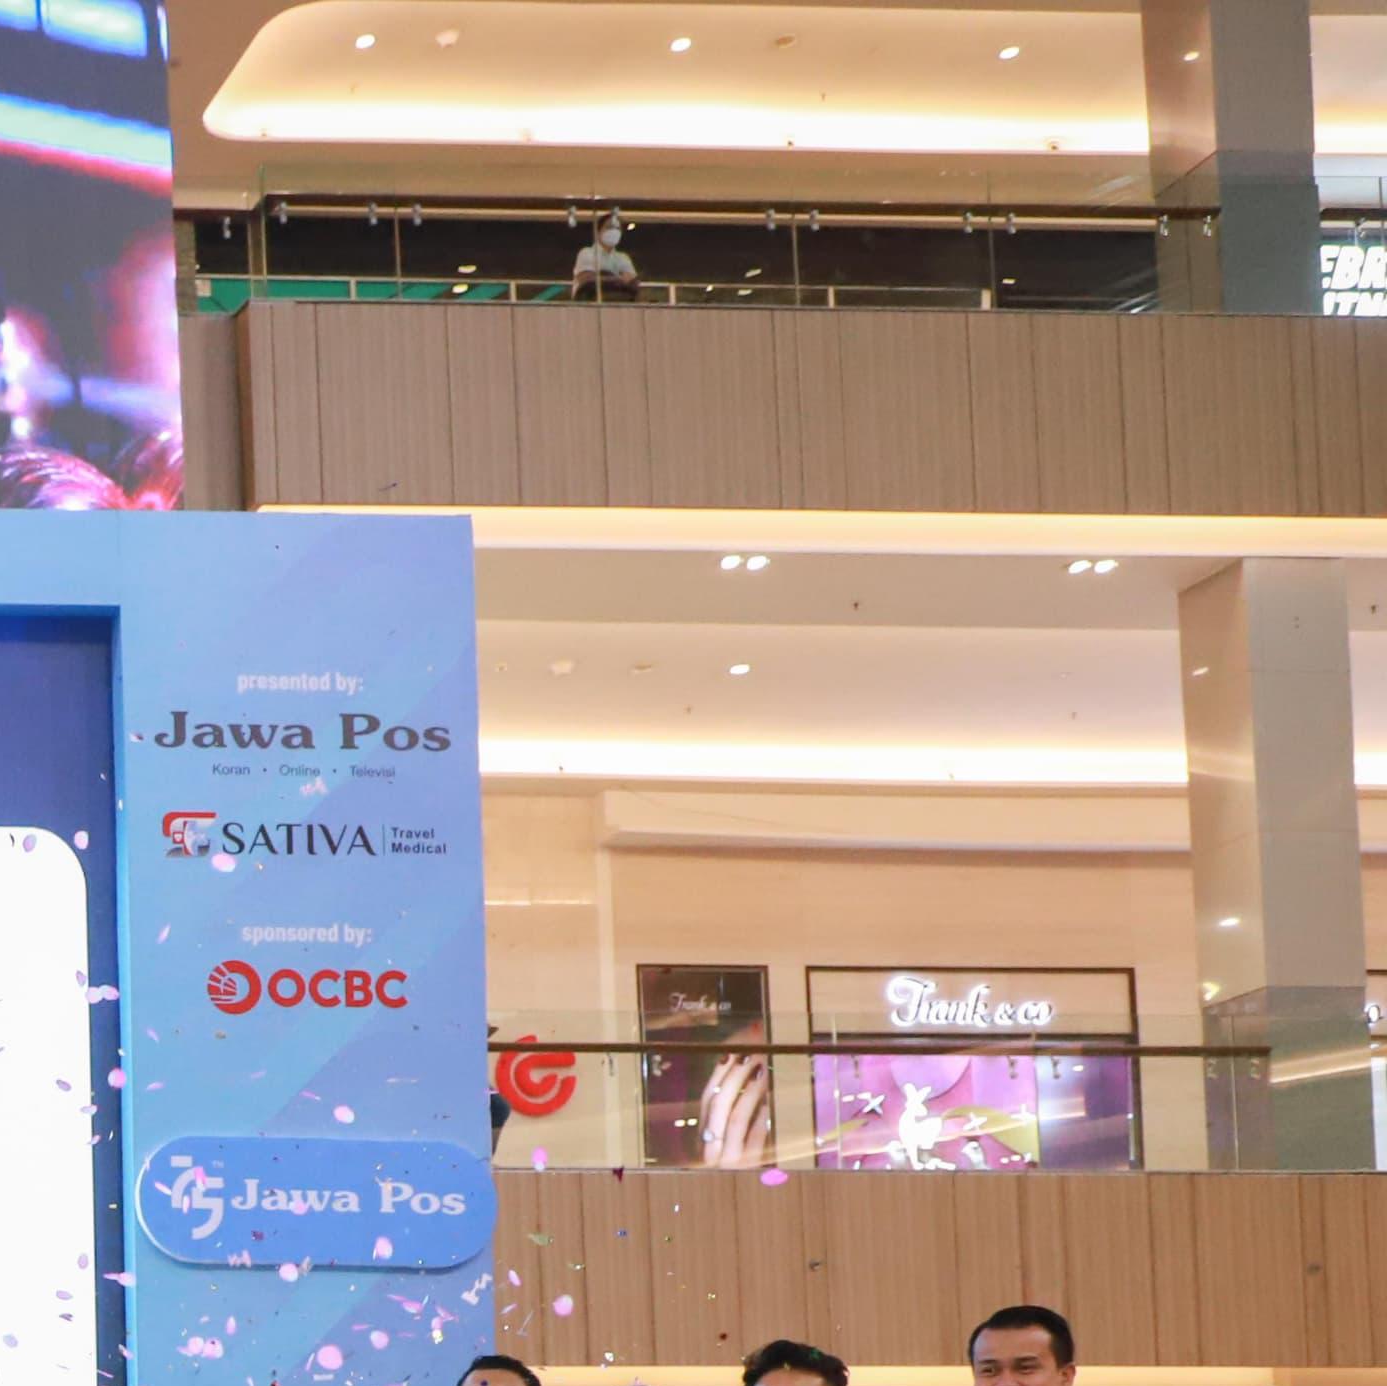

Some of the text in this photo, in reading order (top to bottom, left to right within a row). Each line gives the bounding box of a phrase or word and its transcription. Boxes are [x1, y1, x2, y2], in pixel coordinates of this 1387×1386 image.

[237, 672, 363, 696] presented by:
[154, 711, 452, 752] Jawa Pos
[212, 764, 396, 778] Koran Online Televisi
[222, 823, 376, 856] SATIVA
[392, 827, 435, 839] Travel
[391, 842, 447, 854] Medical
[241, 924, 372, 945] sponsored by:
[268, 969, 407, 1007] OCBC
[231, 1179, 466, 1216] Jawa Pos
